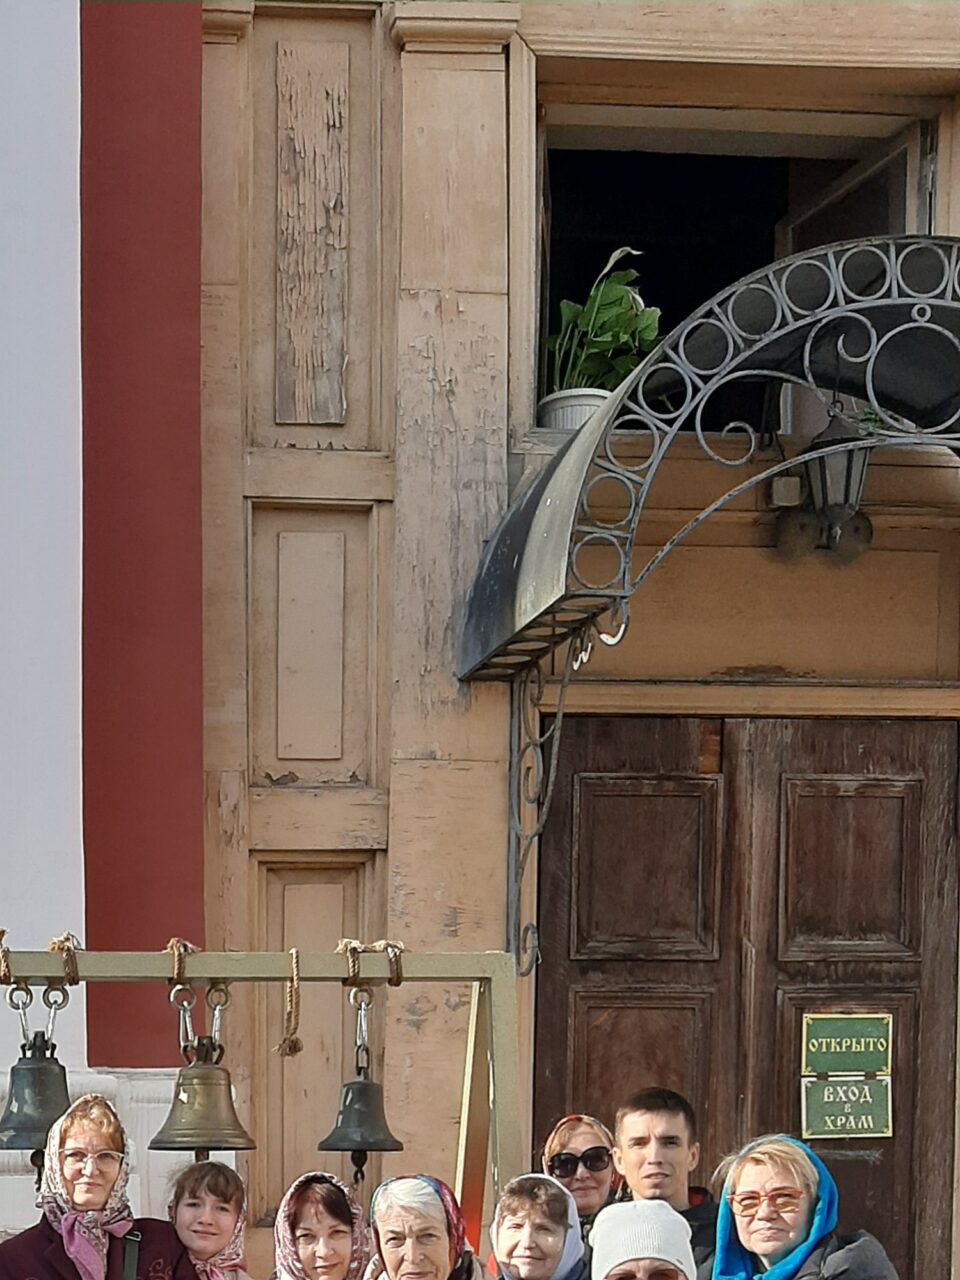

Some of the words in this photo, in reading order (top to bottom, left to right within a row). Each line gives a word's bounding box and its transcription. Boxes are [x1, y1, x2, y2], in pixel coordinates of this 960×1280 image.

[808, 1038, 887, 1052] ОТКРЫТО
[823, 1086, 872, 1103] ВХОД
[824, 1115, 874, 1130] ХРАМ
